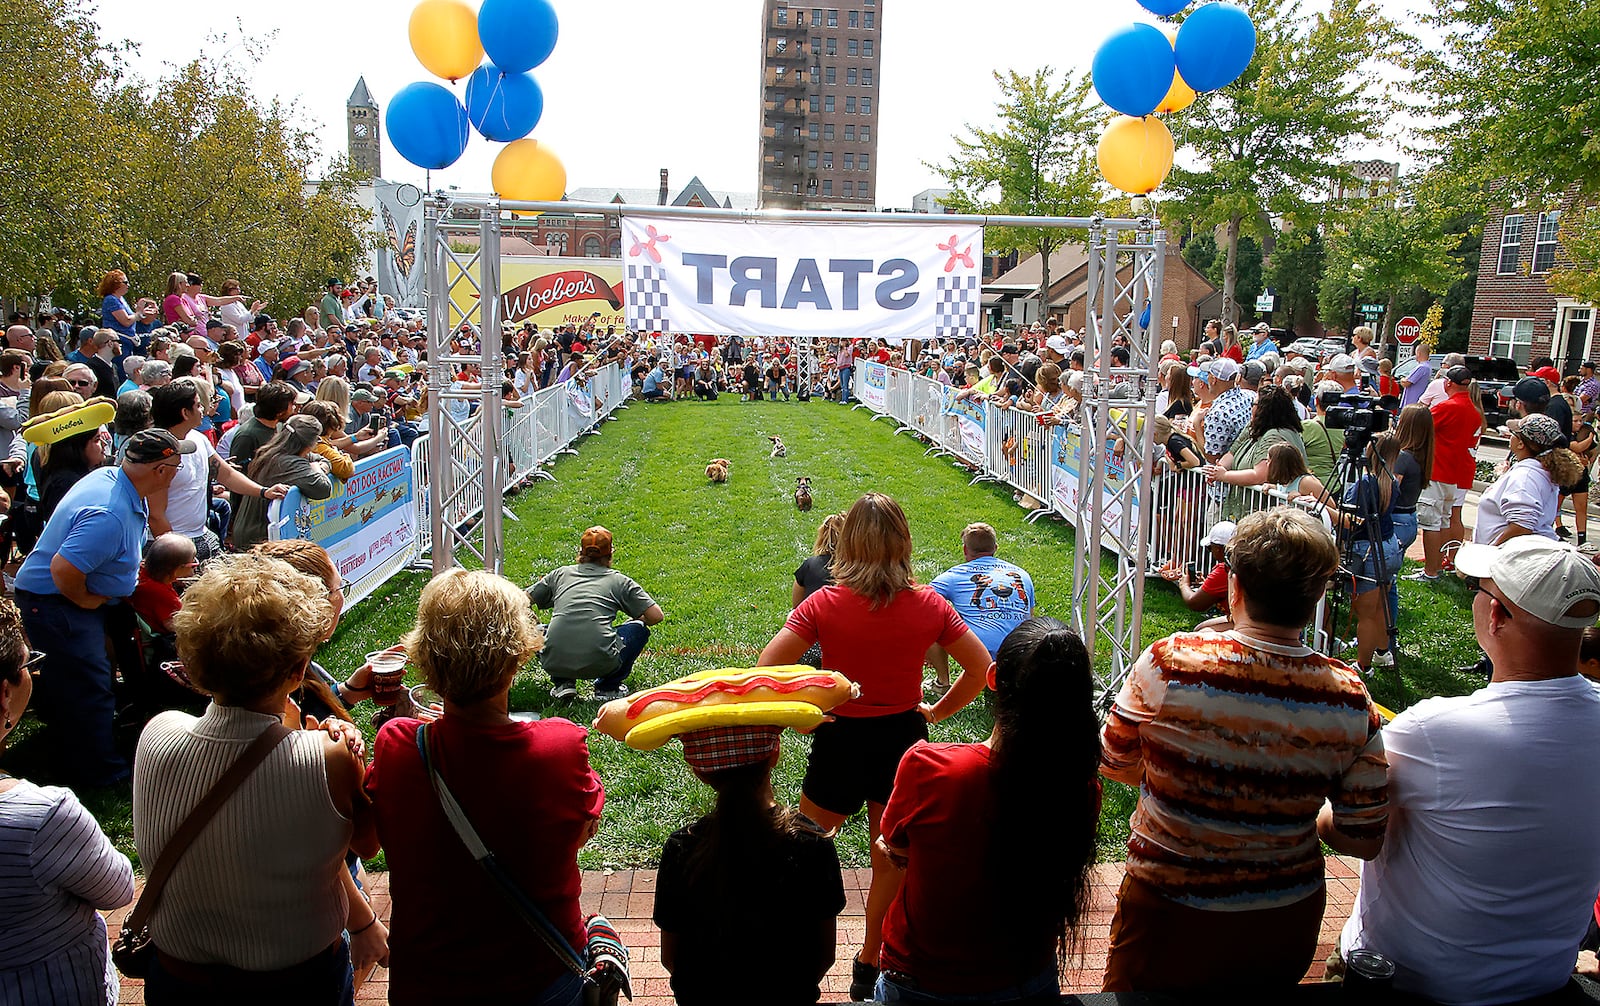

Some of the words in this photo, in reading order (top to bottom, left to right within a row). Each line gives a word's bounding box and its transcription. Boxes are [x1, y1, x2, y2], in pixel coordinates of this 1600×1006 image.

[503, 273, 596, 321] Woeber's
[563, 314, 598, 325] Makes
[600, 314, 613, 325] of
[1397, 325, 1420, 337] STOP
[346, 479, 361, 498] HOT
[361, 472, 377, 490] DOG
[377, 458, 405, 484] RACEWAY
[986, 611, 1012, 620] GOOD
